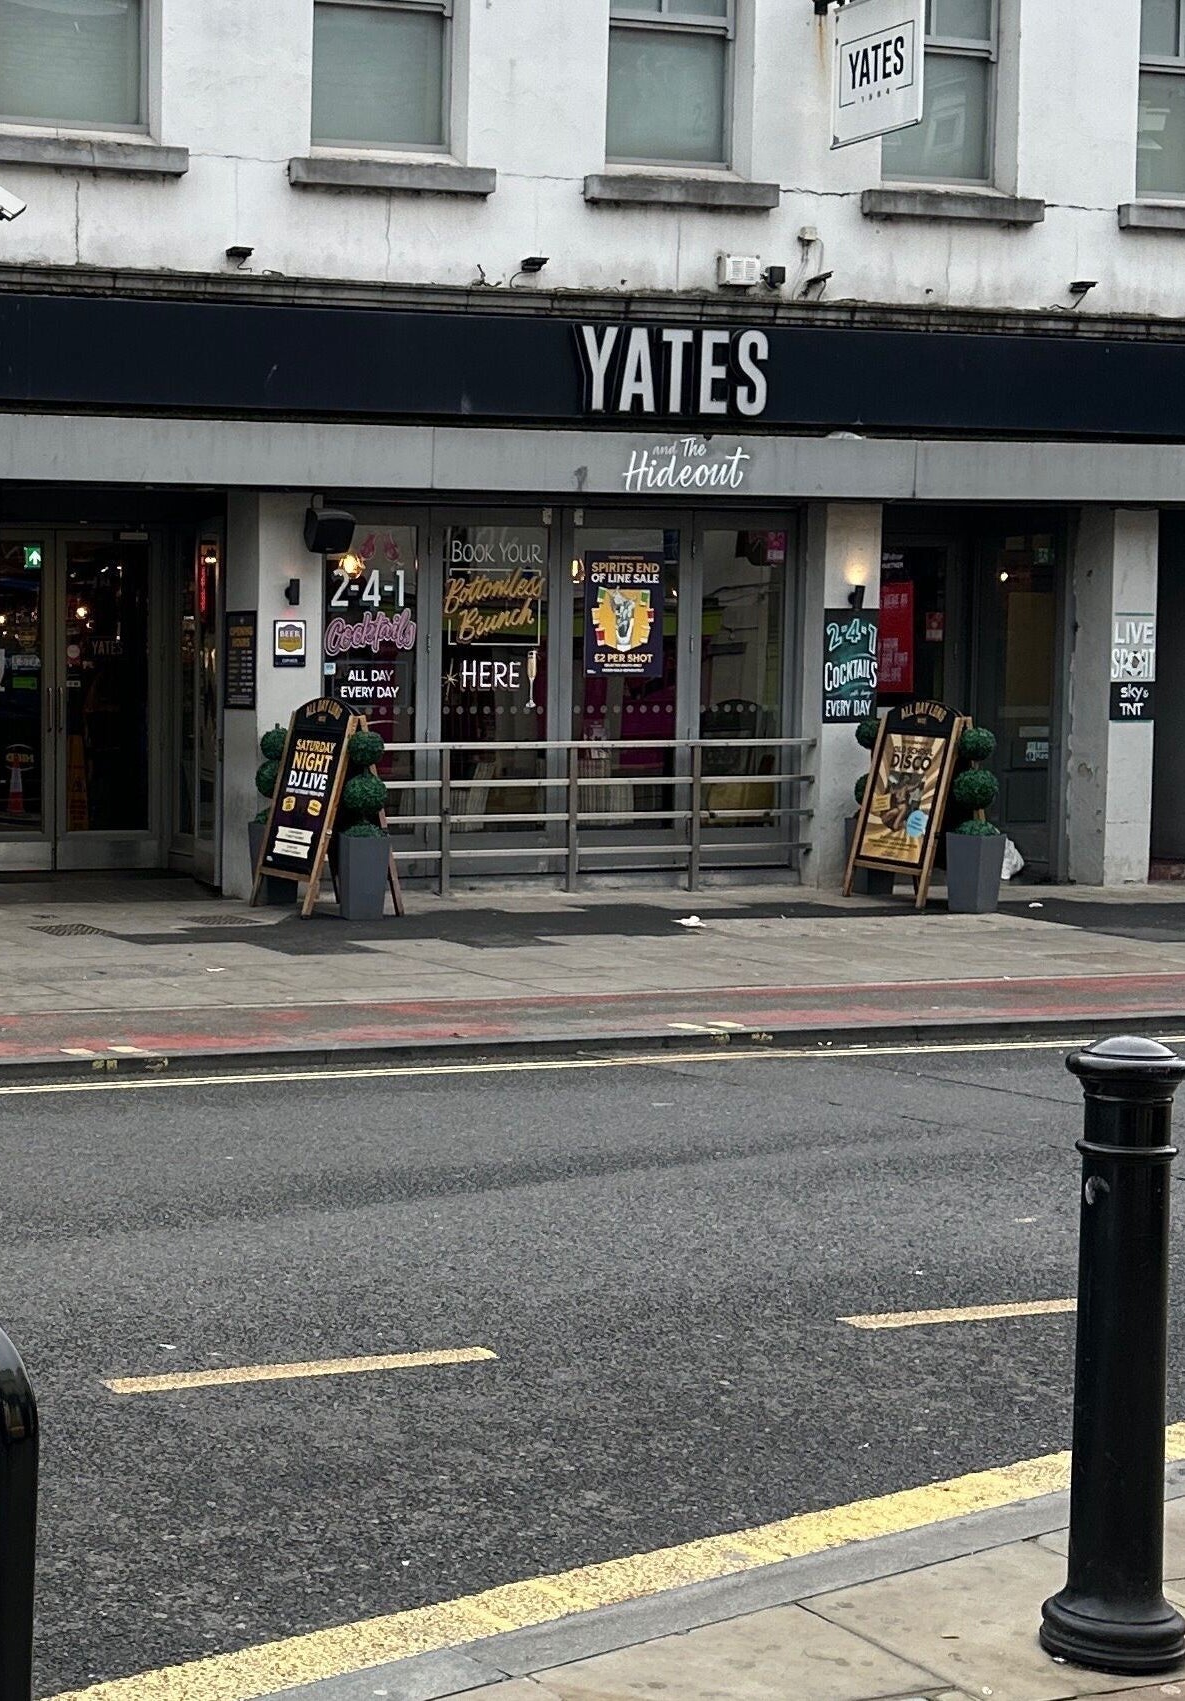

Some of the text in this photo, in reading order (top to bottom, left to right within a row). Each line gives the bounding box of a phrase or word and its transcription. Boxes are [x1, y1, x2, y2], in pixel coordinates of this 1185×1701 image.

[848, 36, 905, 89] YATES
[582, 325, 770, 416] YATES
[653, 437, 707, 458] and The
[622, 446, 751, 492] Hideout
[451, 540, 544, 565] BOOK YOUR
[591, 562, 660, 574] SPIRITS END
[591, 573, 660, 584] OF LINE SALE
[330, 569, 406, 607] 2-4-1
[444, 566, 546, 614] Bottomless
[324, 607, 418, 656] Cocktails
[457, 598, 535, 643] Brunch
[1114, 621, 1155, 645] LIVE
[594, 653, 653, 663] £2 PER SHOT
[1110, 648, 1156, 679] SPORT
[347, 669, 395, 682] ALL DAY
[461, 660, 521, 688] HERE
[340, 686, 400, 699] EVERY DAY
[1120, 683, 1144, 702] sky
[825, 699, 872, 717] EVERY DAY
[901, 704, 914, 720] ALL
[914, 701, 930, 715] DAY
[1118, 702, 1145, 716] TNT
[295, 738, 337, 754] SATURDAY
[292, 751, 334, 774] NIGHT
[890, 753, 932, 772] DISCO
[287, 769, 329, 791] DJ LIVE
